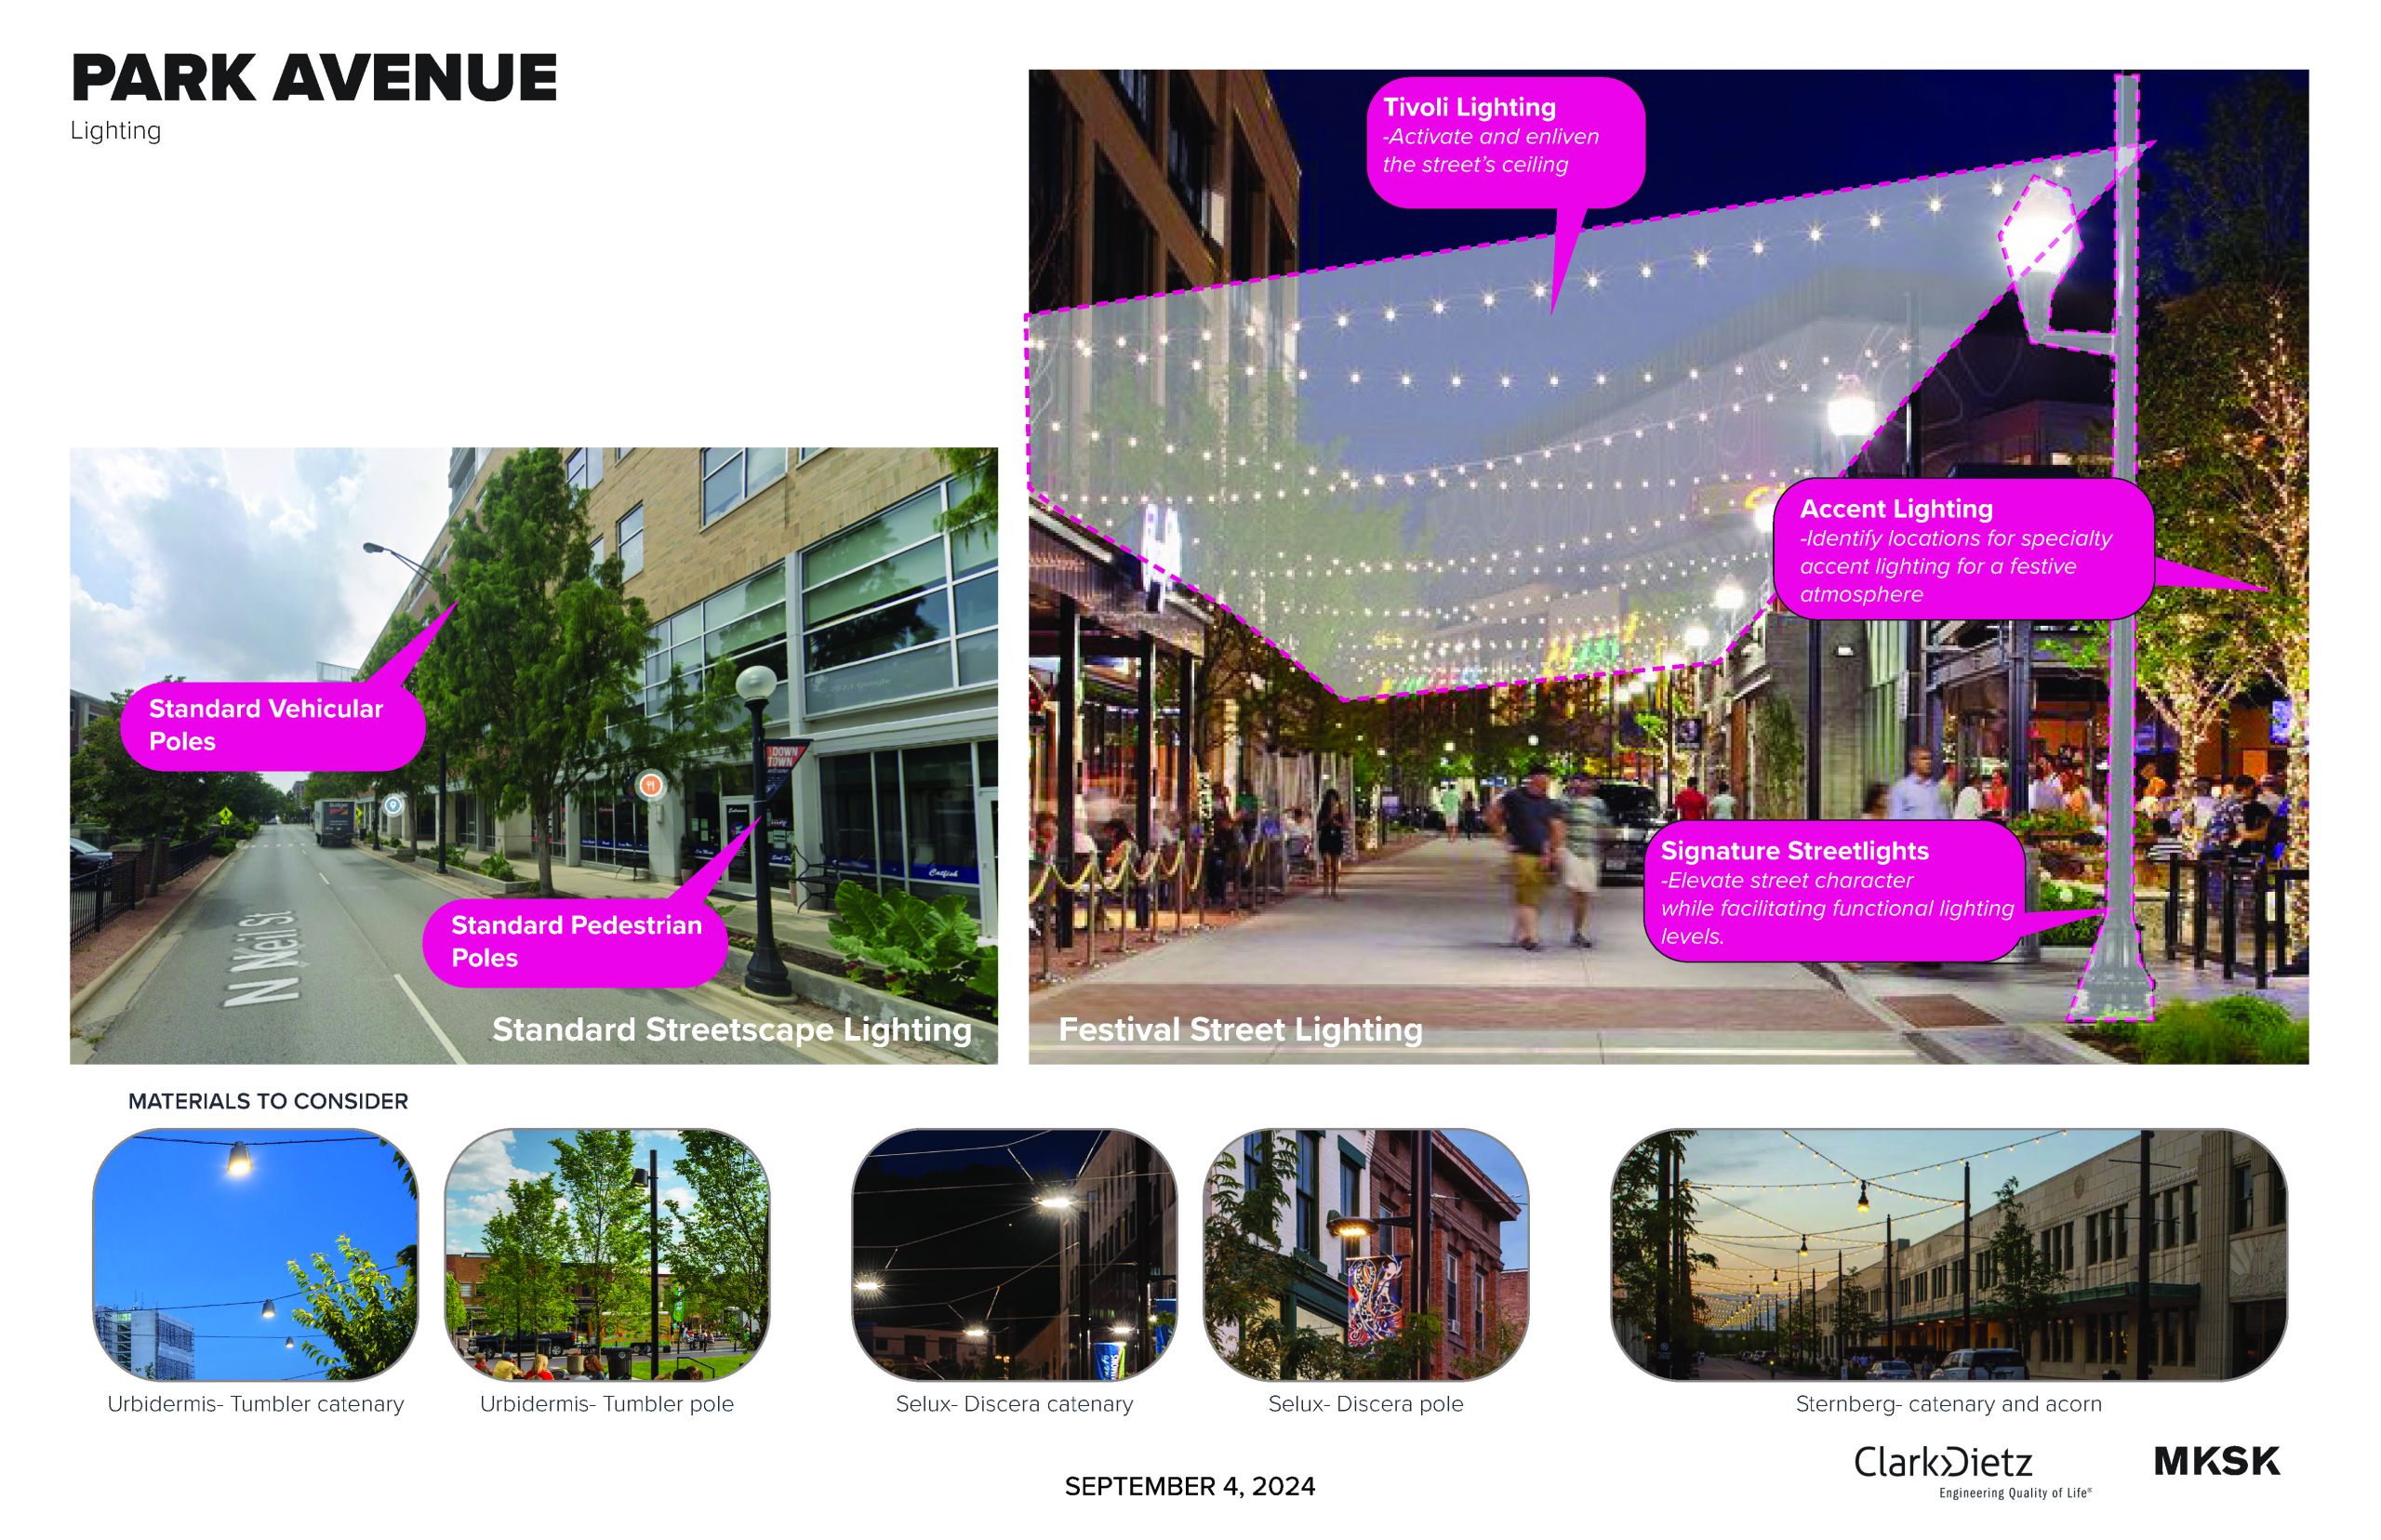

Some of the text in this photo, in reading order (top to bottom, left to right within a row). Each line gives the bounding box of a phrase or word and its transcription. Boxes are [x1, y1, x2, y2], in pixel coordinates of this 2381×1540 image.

[773, 746, 798, 756] DOWN
[767, 756, 792, 767] TOWN
[928, 869, 959, 879] Catfish
